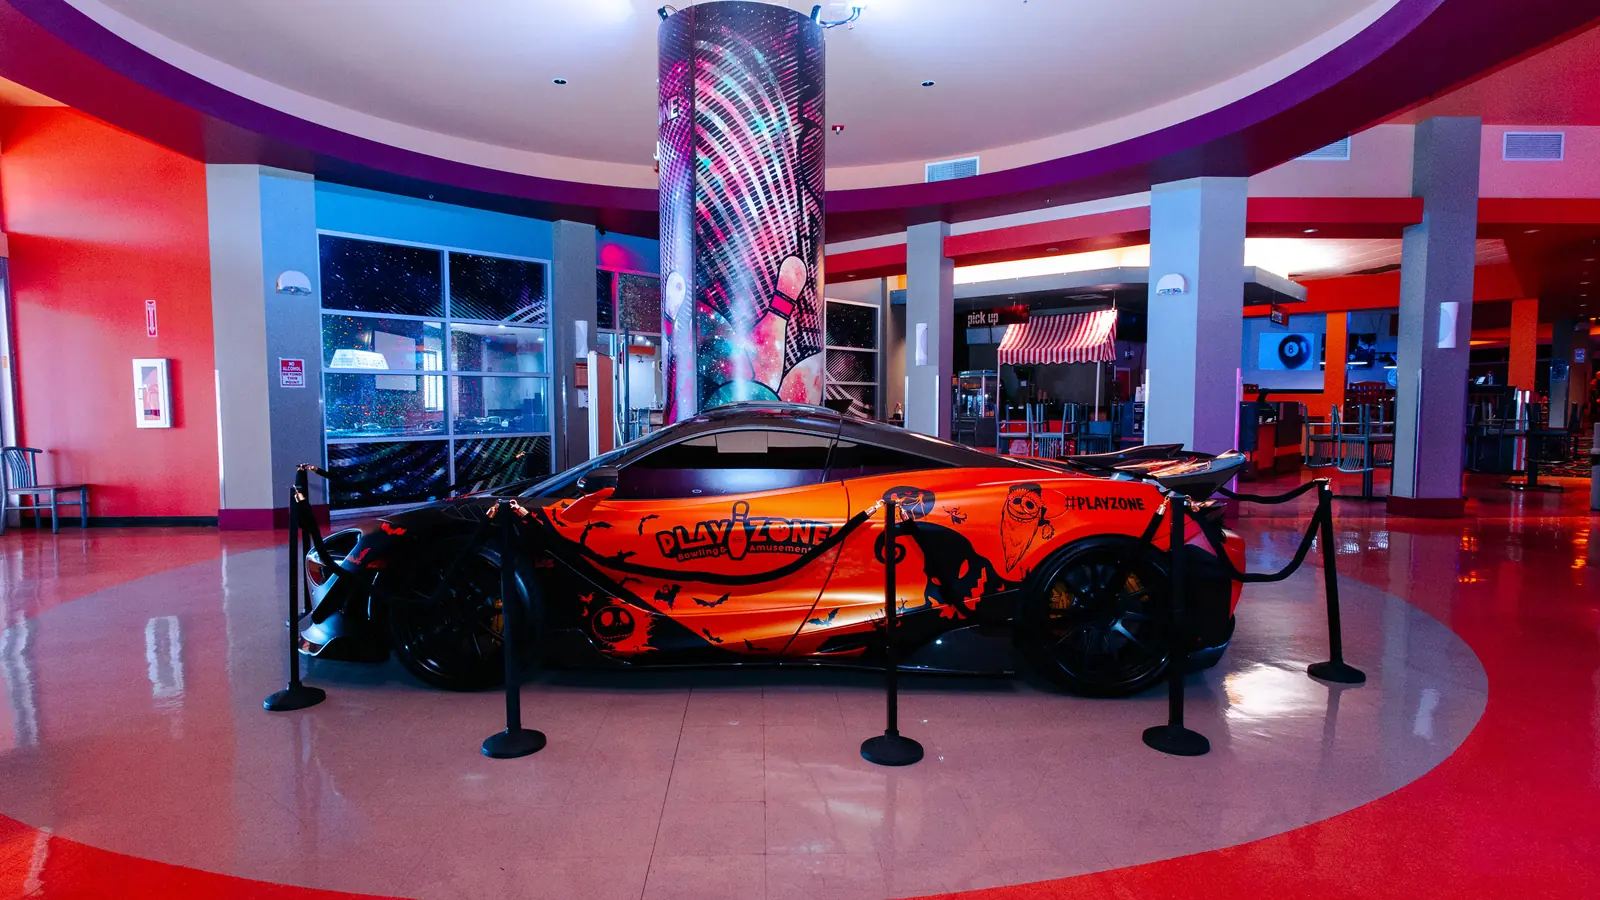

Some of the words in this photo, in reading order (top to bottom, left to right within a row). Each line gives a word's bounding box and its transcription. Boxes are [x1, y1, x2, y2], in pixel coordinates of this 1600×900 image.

[967, 311, 986, 328] pick
[988, 311, 999, 326] up
[1065, 495, 1145, 511] #PLAYZONE
[657, 519, 729, 556] PLAY
[749, 517, 832, 545] ZONE
[677, 546, 719, 561] Bowling
